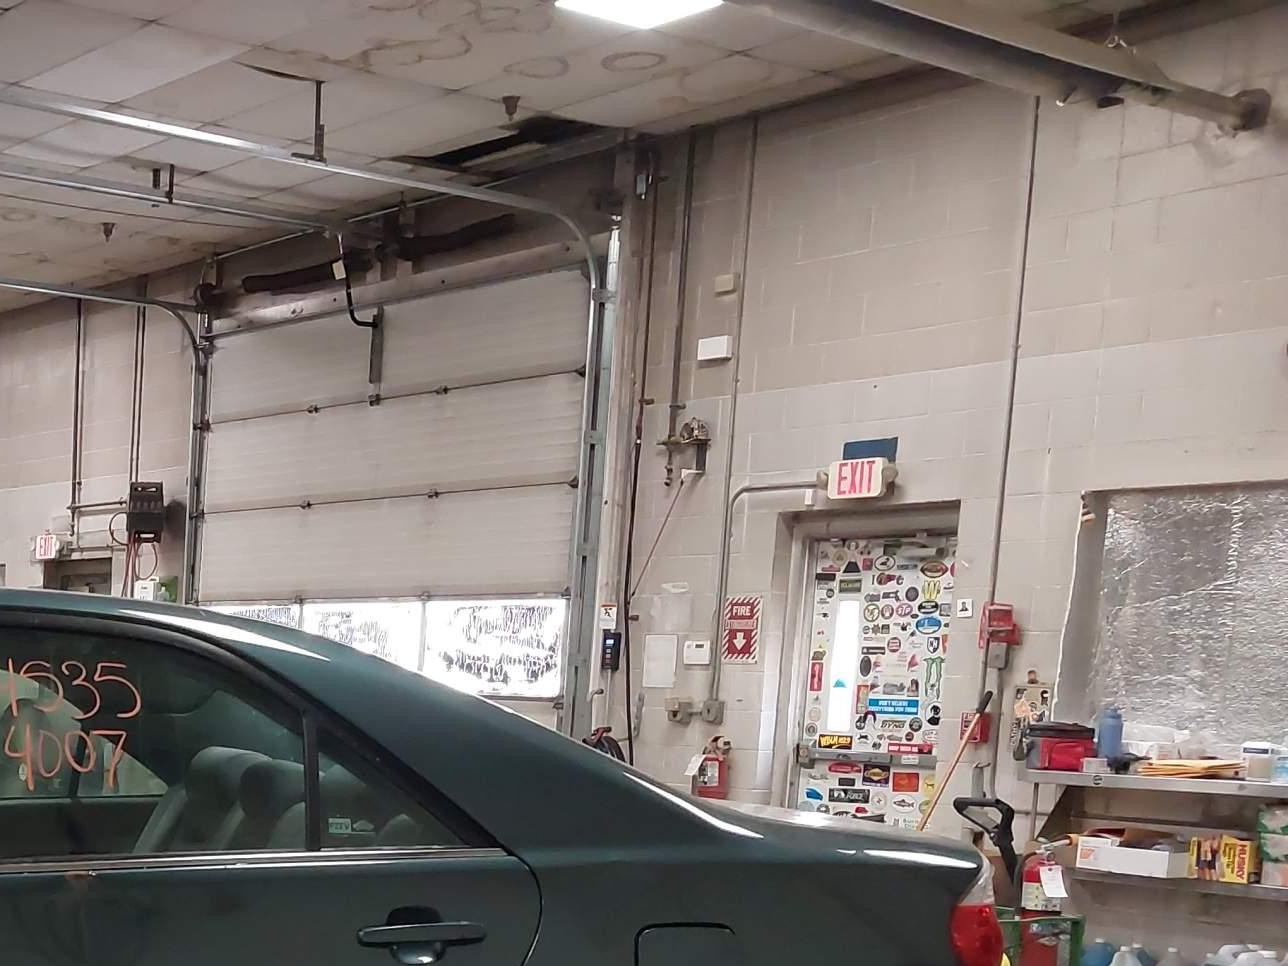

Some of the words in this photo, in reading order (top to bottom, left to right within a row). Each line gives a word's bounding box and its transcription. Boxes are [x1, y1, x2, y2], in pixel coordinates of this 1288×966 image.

[837, 460, 876, 496] EXIT
[39, 536, 54, 557] EXIT
[732, 605, 752, 617] FIRE
[4, 723, 128, 792] 4007
[1235, 844, 1249, 880] HUSKY
